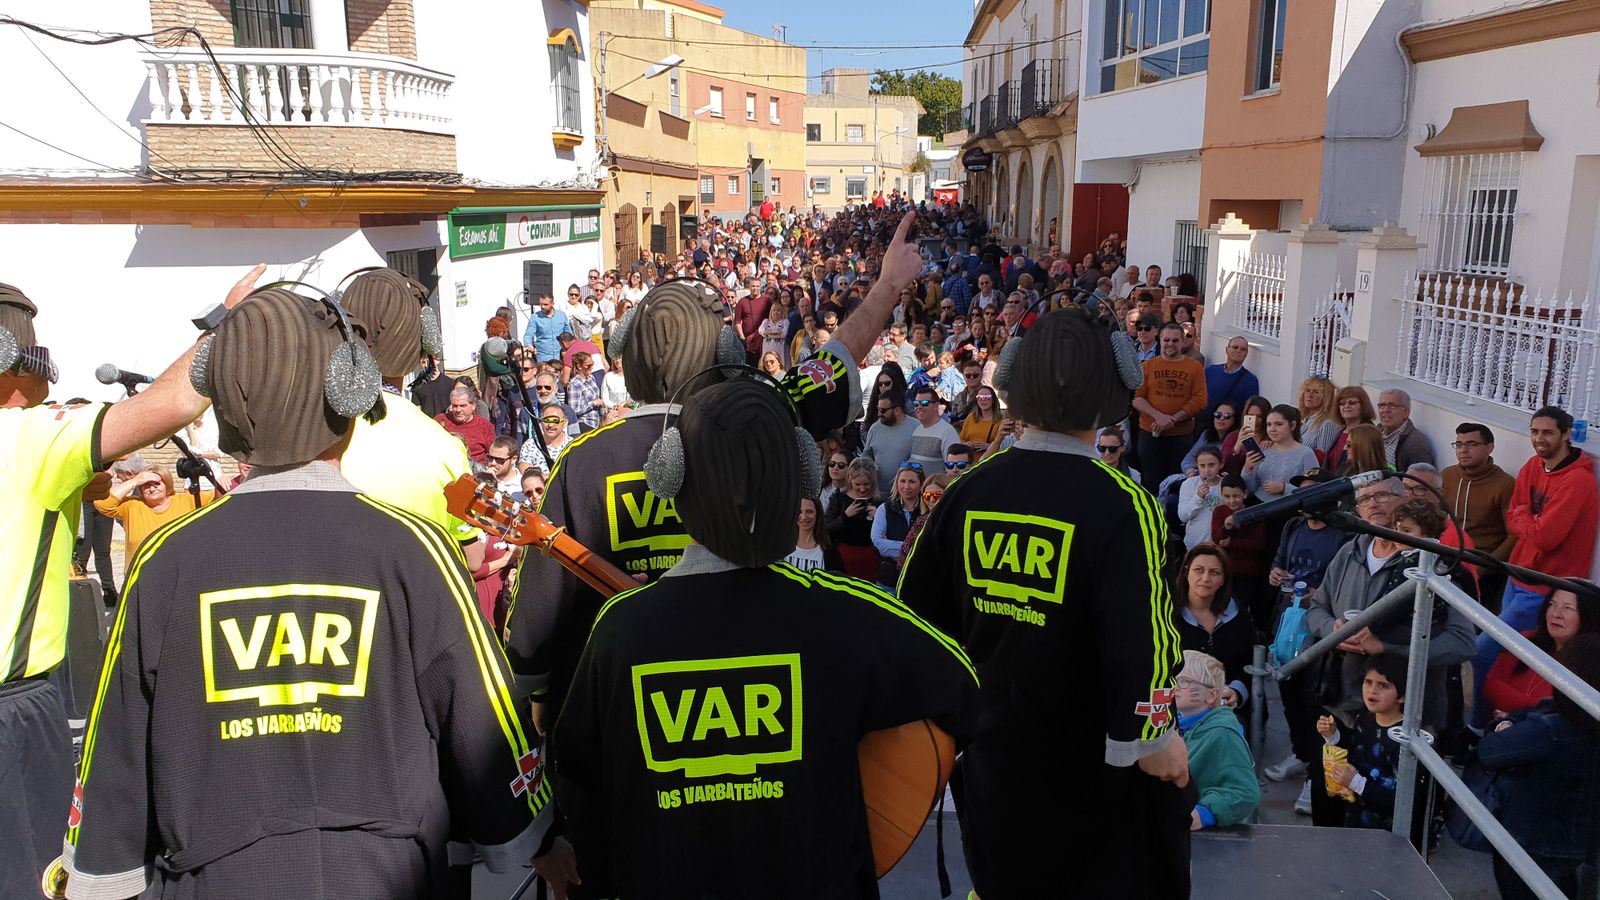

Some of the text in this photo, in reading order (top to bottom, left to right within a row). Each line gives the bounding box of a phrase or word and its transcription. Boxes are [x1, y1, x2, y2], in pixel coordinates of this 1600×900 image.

[459, 224, 499, 246] Estamos ahí
[1360, 274, 1369, 290] 19
[1154, 370, 1189, 383] DIESEL
[621, 490, 683, 529] VA
[626, 559, 648, 571] LOS
[974, 530, 1055, 579] VAR
[219, 612, 352, 671] VAR
[650, 683, 785, 743] VAR
[1153, 703, 1168, 712] VA
[220, 707, 343, 740] LOS VARBAEÑOS
[684, 777, 784, 804] VARBATEÑOS
